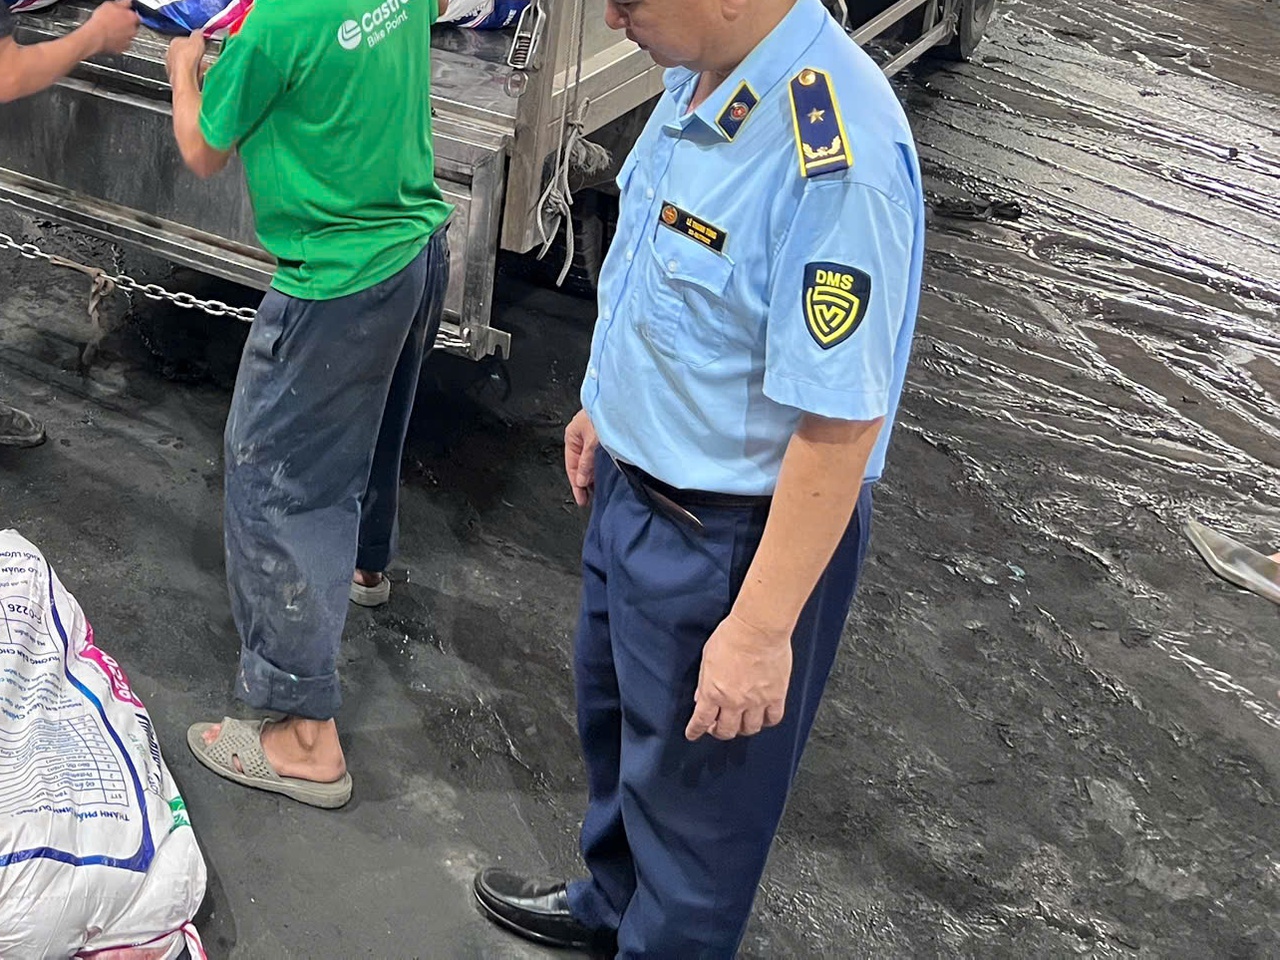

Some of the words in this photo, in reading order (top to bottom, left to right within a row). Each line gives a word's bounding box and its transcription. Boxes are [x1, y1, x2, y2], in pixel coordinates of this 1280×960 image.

[367, 28, 386, 48] Bike
[386, 10, 409, 34] Point
[816, 269, 854, 291] DMS
